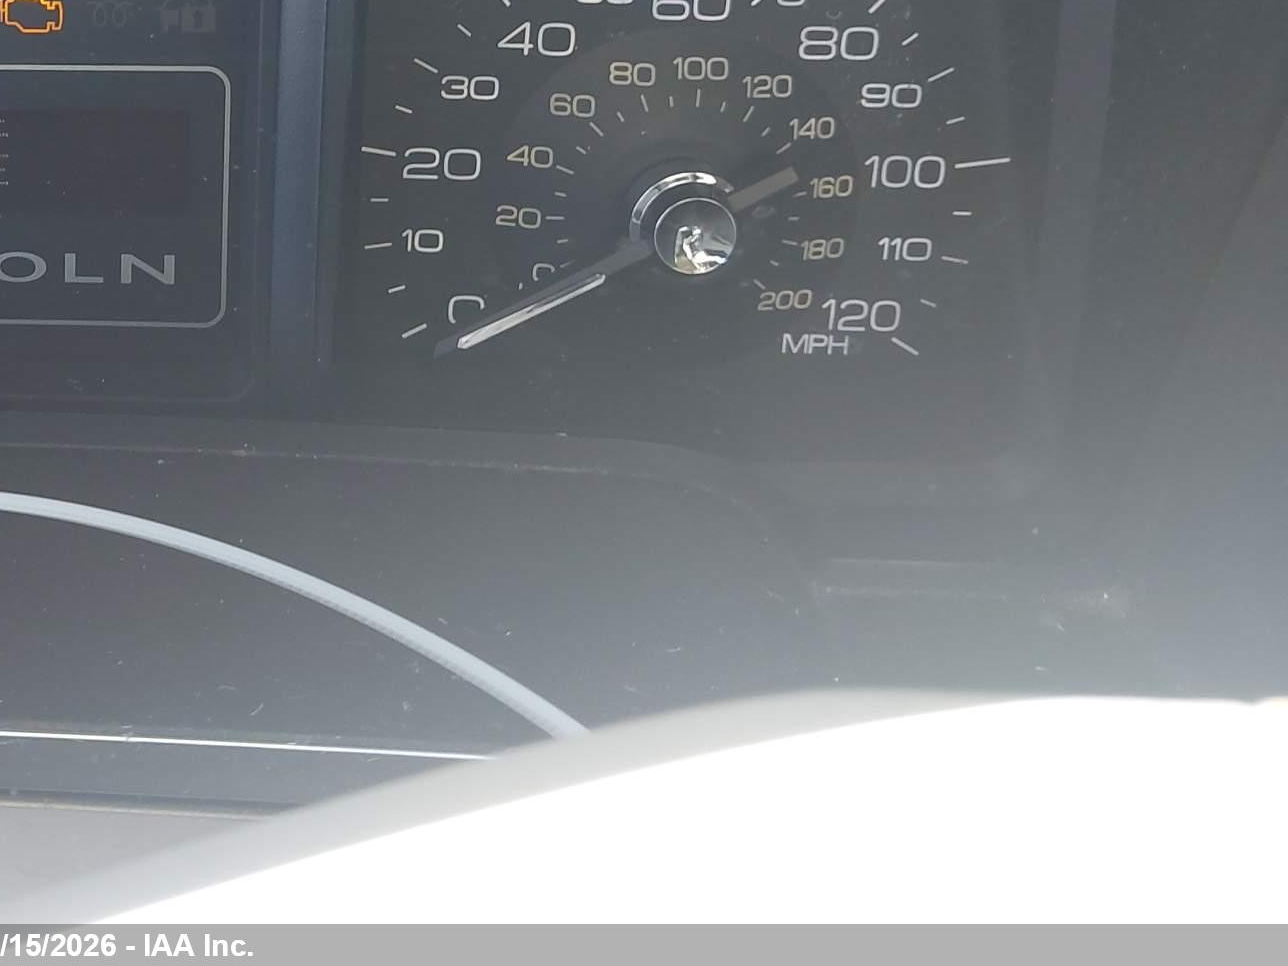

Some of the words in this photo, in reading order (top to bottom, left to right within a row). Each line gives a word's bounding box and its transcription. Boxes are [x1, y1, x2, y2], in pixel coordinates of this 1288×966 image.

[497, 21, 576, 57] 40
[798, 26, 880, 61] 80
[609, 61, 656, 87] 80
[672, 56, 729, 81] 100
[440, 75, 500, 101] 30
[742, 74, 793, 99] 120
[860, 83, 922, 108] 90
[549, 93, 596, 118] 60
[789, 116, 835, 140] 140
[402, 147, 482, 181] 20
[506, 145, 554, 169] 40
[864, 155, 946, 189] 100
[809, 174, 854, 199] 160
[495, 204, 542, 229] 20
[401, 229, 444, 253] 10
[800, 237, 845, 261] 180
[878, 237, 932, 262] 110
[757, 289, 813, 311] 200
[822, 298, 901, 332] 120
[781, 334, 850, 356] MPH
